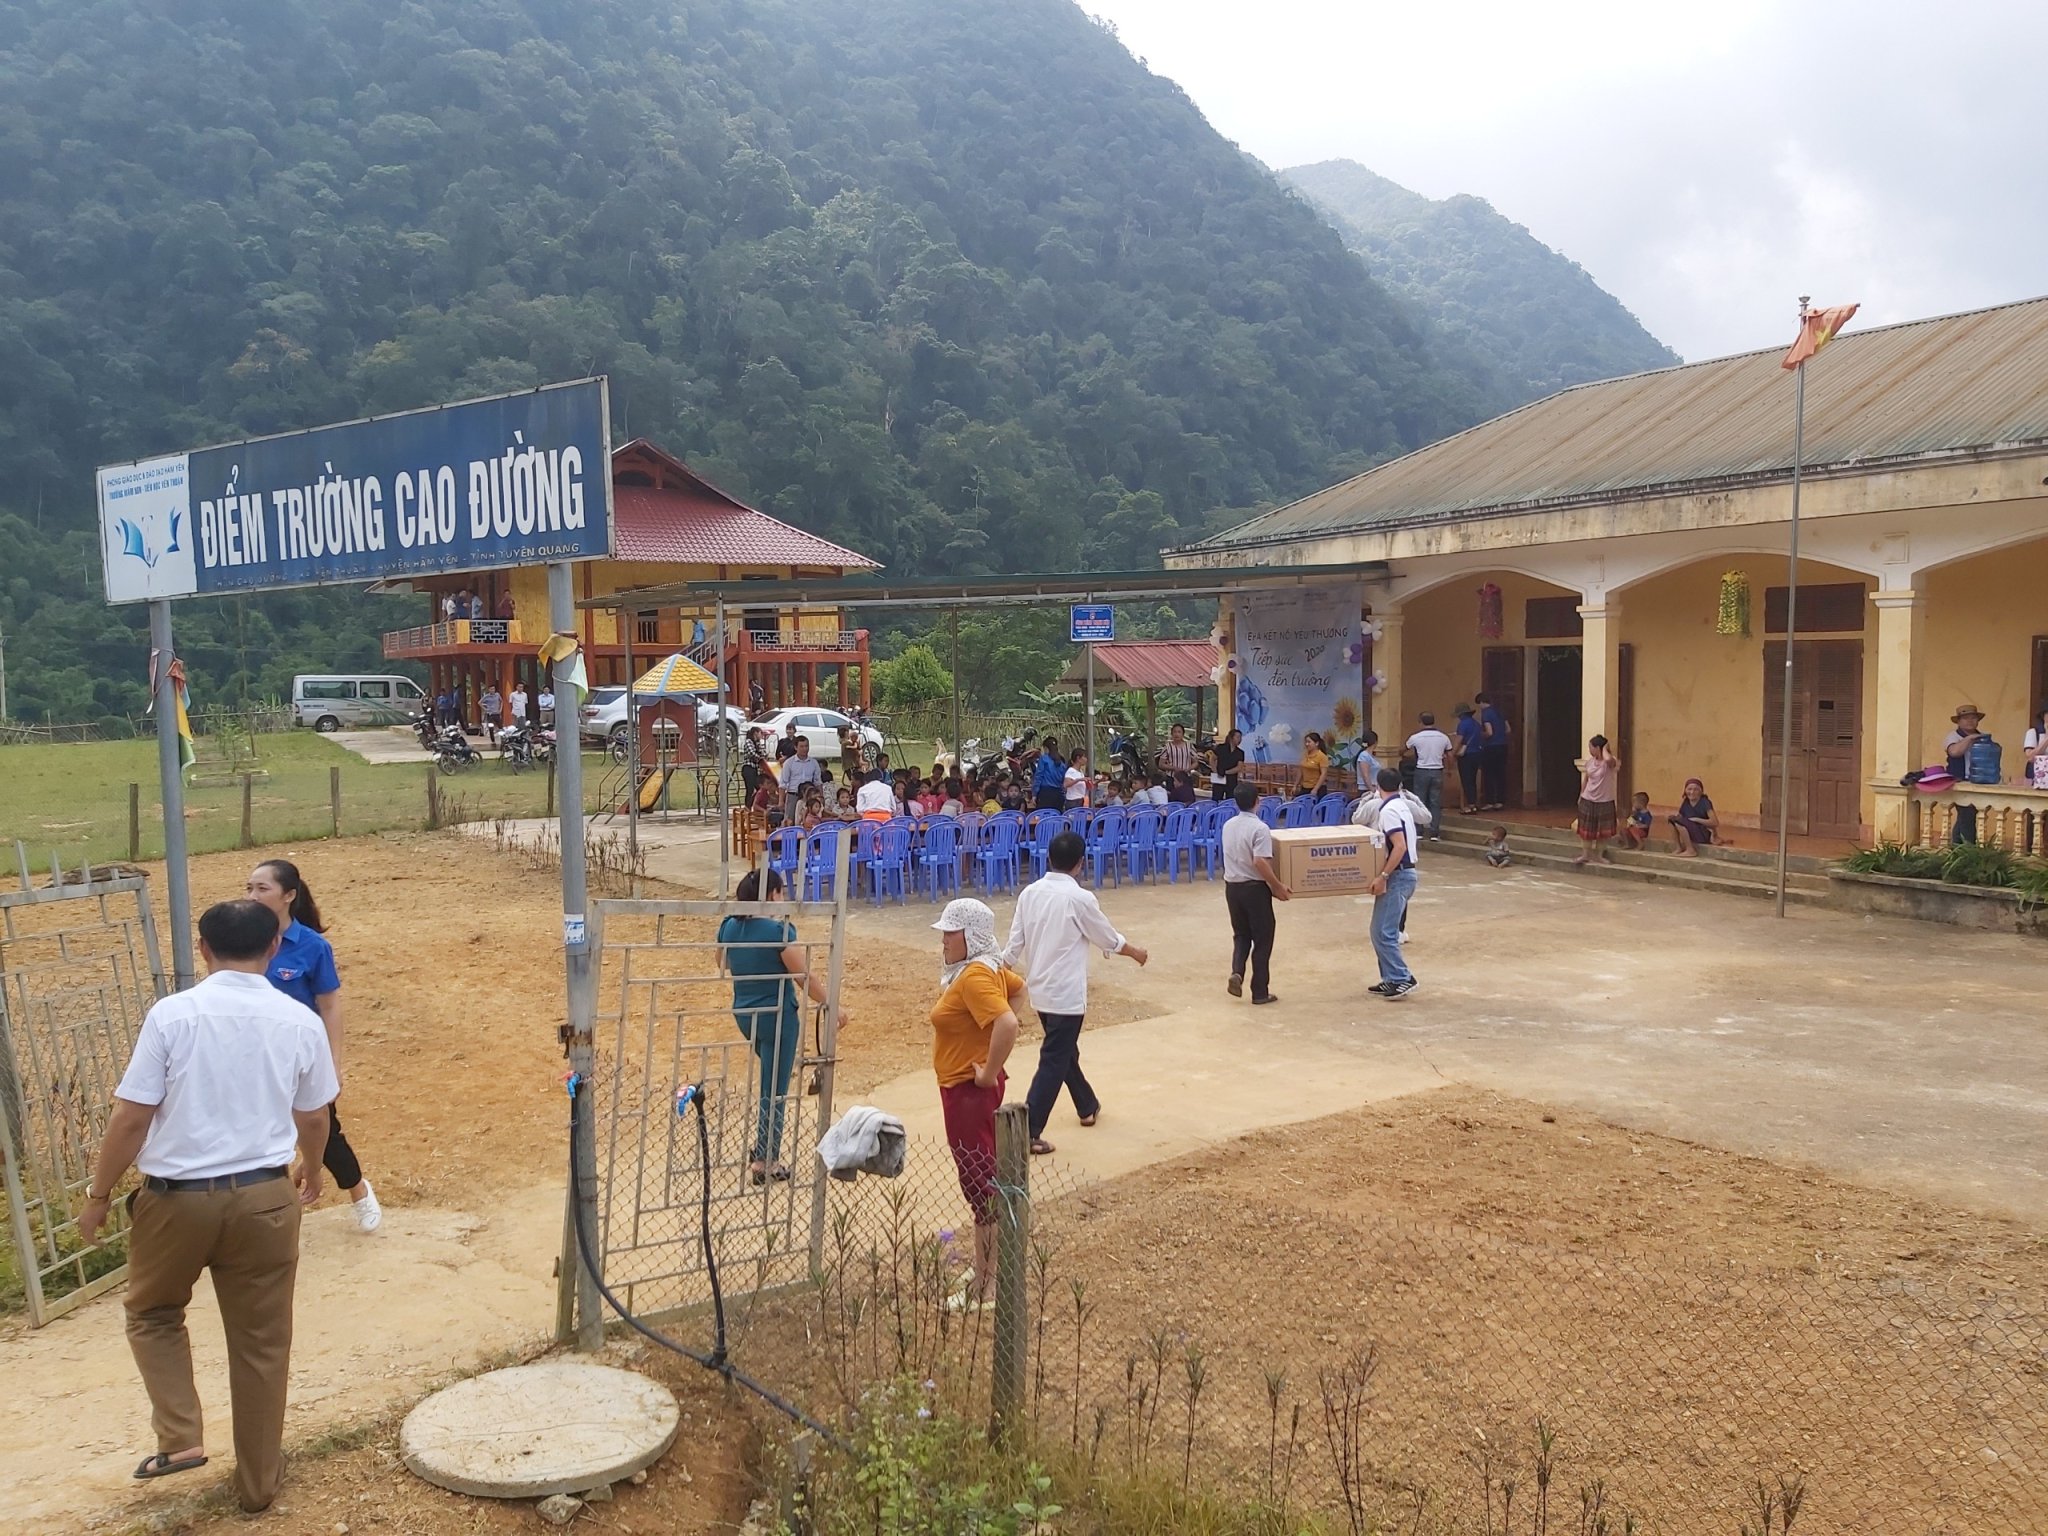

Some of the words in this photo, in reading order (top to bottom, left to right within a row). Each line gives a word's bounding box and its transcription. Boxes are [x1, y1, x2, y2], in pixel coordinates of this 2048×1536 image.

[200, 464, 267, 568] ĐIỂM
[272, 461, 386, 560] TRƯỜNG
[395, 465, 456, 549] CAO
[469, 430, 586, 539] ĐƯỜNG
[438, 553, 459, 566] YÊN
[470, 549, 495, 561] TỈNH
[500, 546, 535, 560] TUYÊN
[538, 543, 580, 556] QUANG
[1280, 628, 1294, 640] NỐ
[1250, 647, 1273, 670] Tiếp
[1267, 668, 1288, 687] đến
[1311, 845, 1357, 858] DUYTAN
